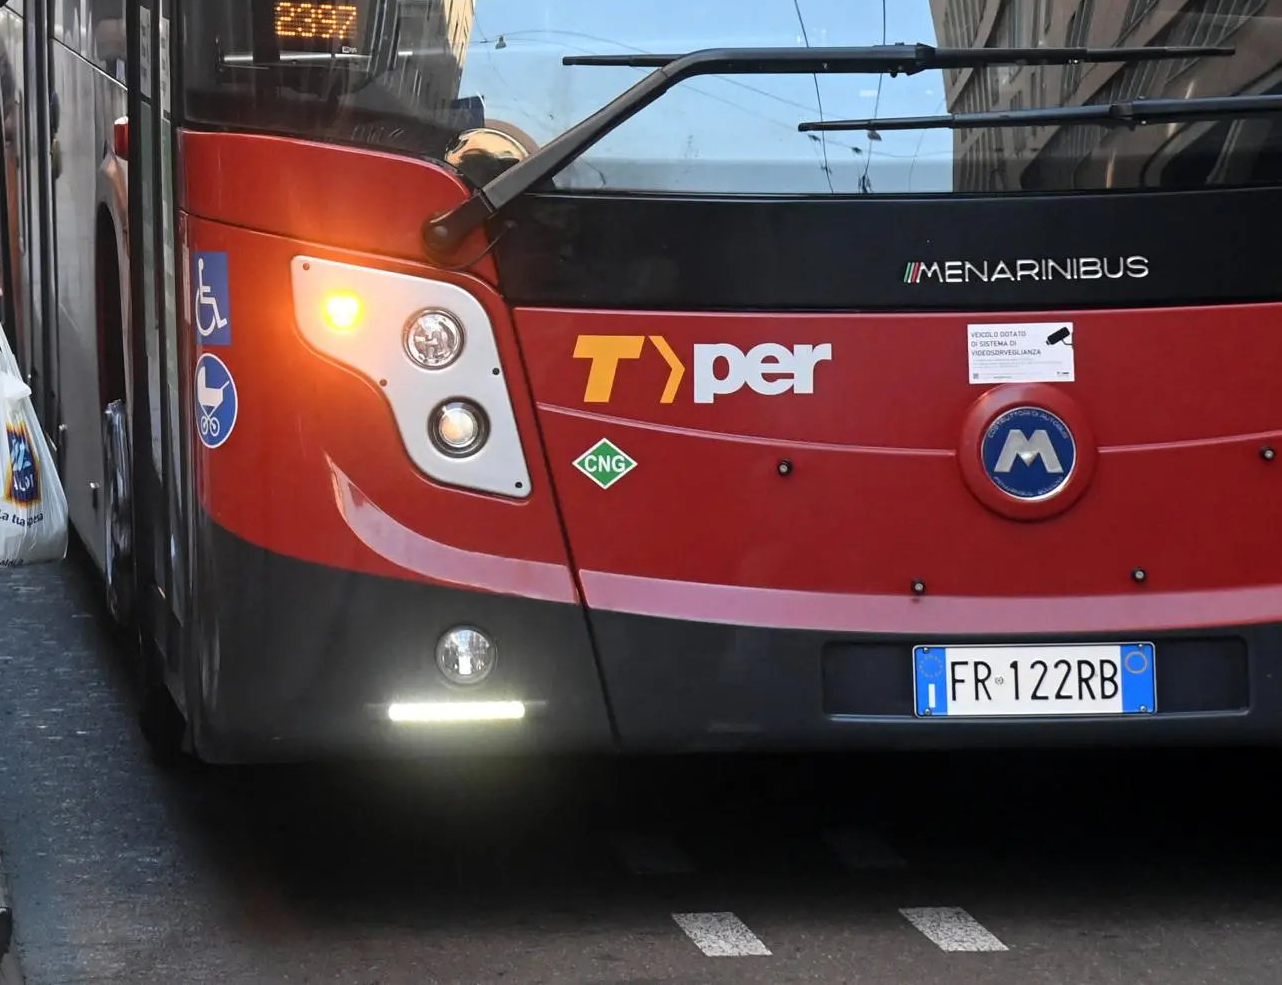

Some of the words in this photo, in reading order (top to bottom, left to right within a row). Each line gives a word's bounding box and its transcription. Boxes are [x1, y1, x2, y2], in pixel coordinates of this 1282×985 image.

[275, 2, 357, 39] 2397
[916, 256, 1149, 283] MENARINIBUS
[1000, 330, 1026, 338] DOTATO
[584, 454, 627, 473] CNG
